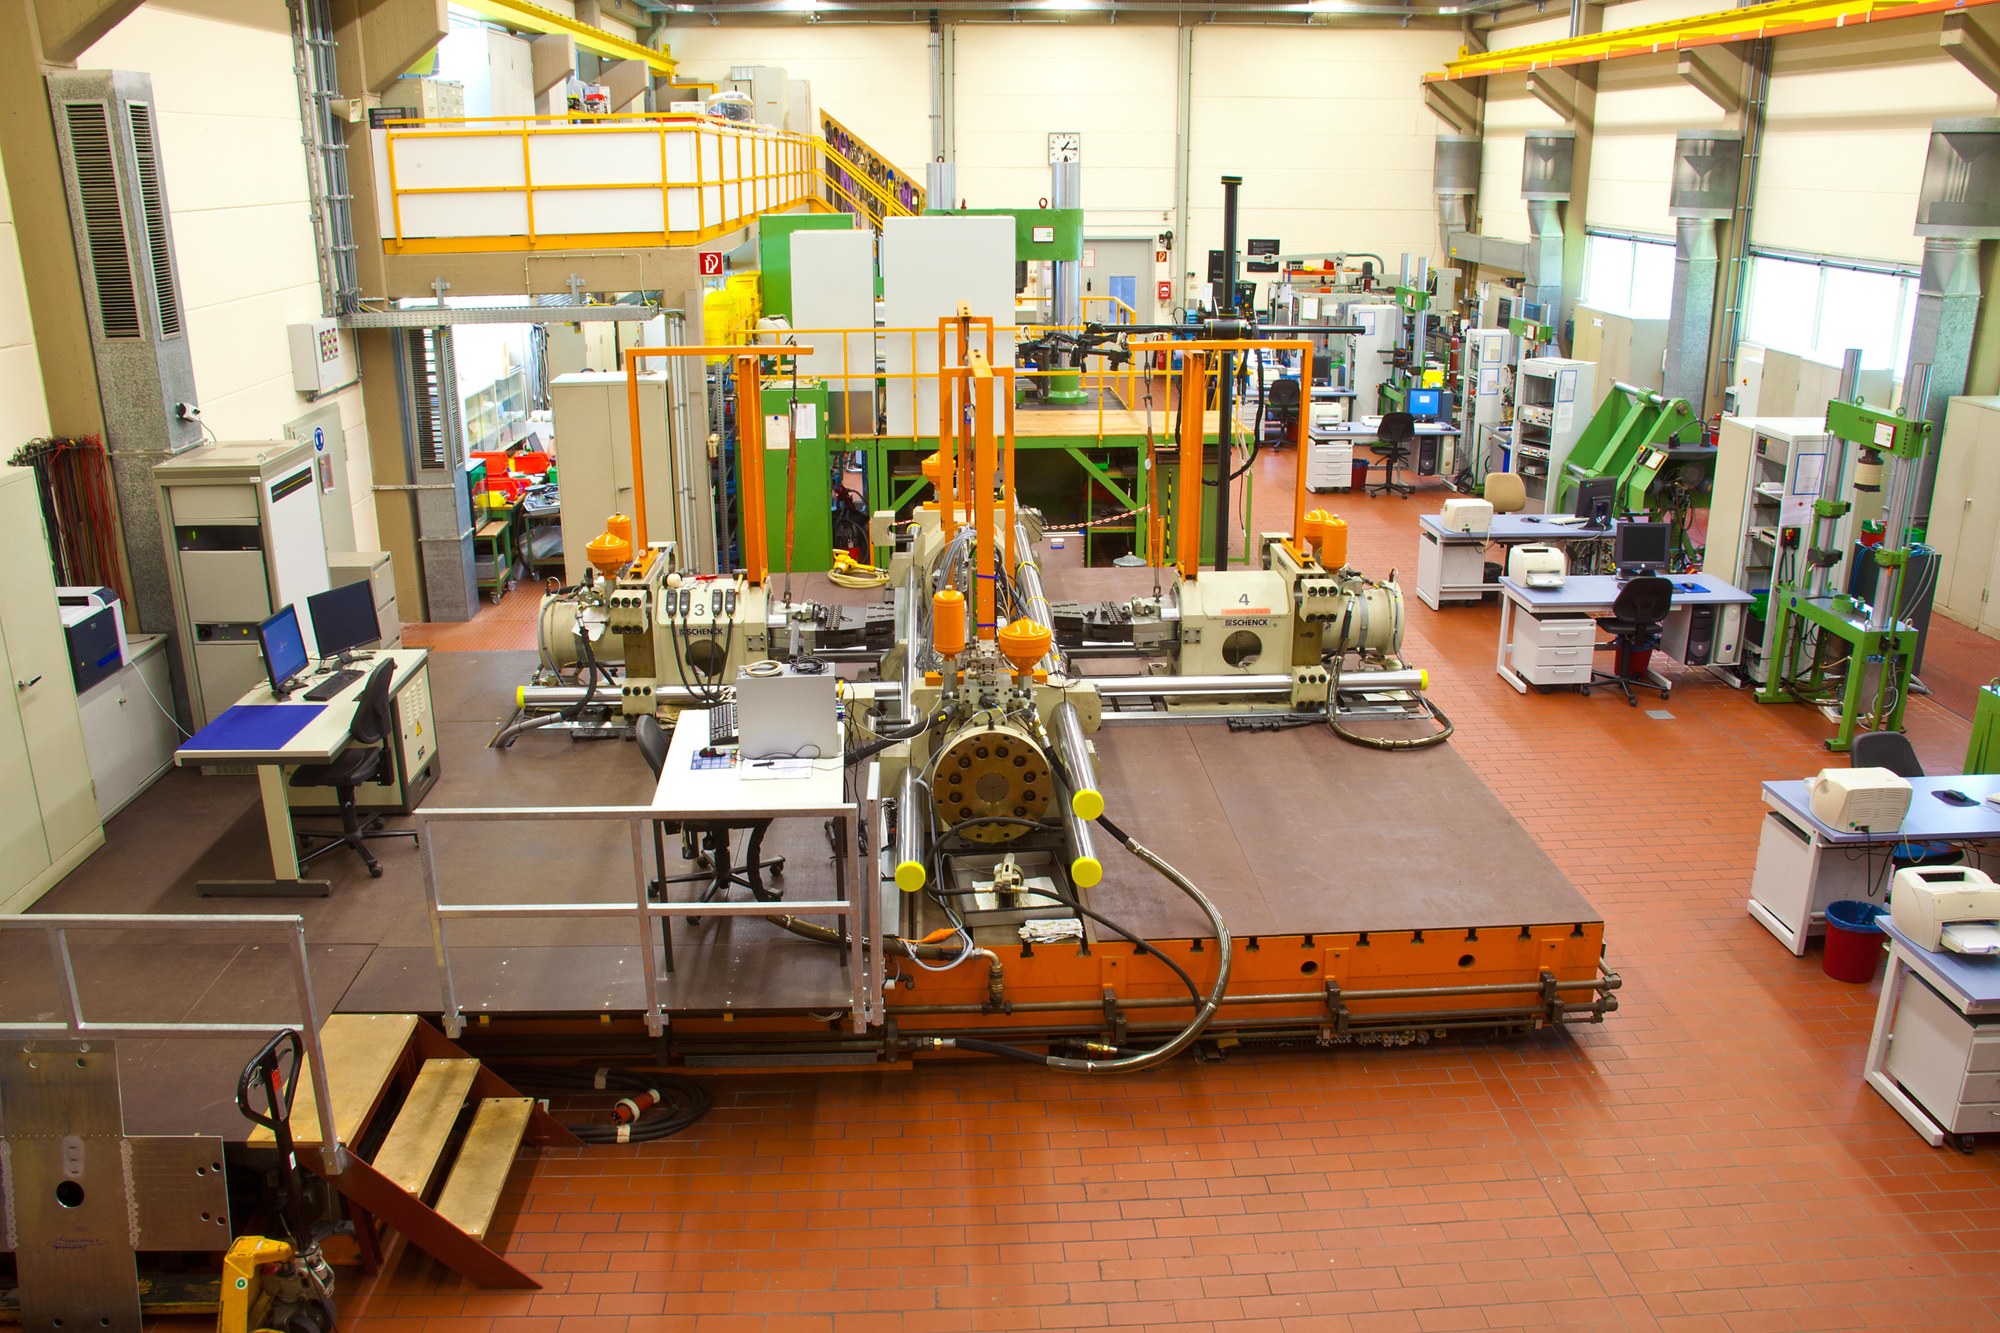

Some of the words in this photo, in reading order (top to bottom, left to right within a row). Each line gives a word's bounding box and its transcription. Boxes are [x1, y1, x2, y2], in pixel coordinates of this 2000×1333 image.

[1238, 593, 1250, 606] 4
[694, 603, 705, 617] 3
[1232, 618, 1268, 627] SCHENCK
[687, 627, 723, 636] SCHENCK
